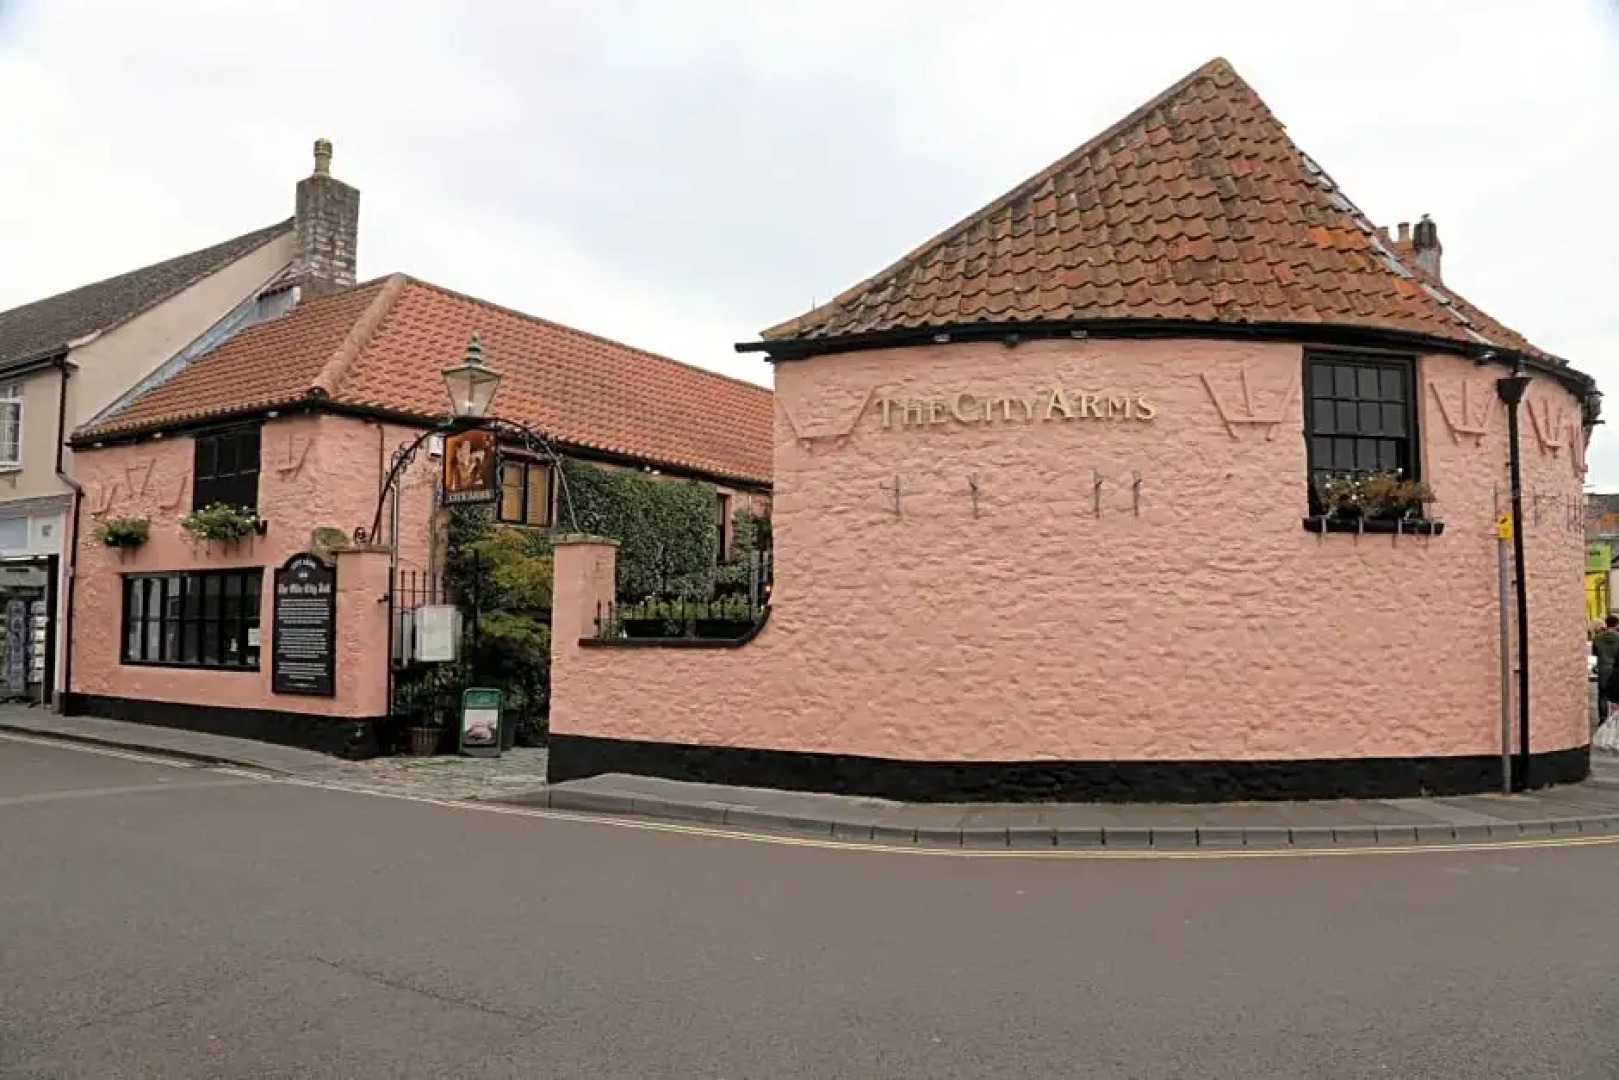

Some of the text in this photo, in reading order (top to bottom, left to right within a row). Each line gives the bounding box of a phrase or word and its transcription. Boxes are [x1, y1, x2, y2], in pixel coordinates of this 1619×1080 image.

[875, 387, 1156, 429] THE CITY ARMS
